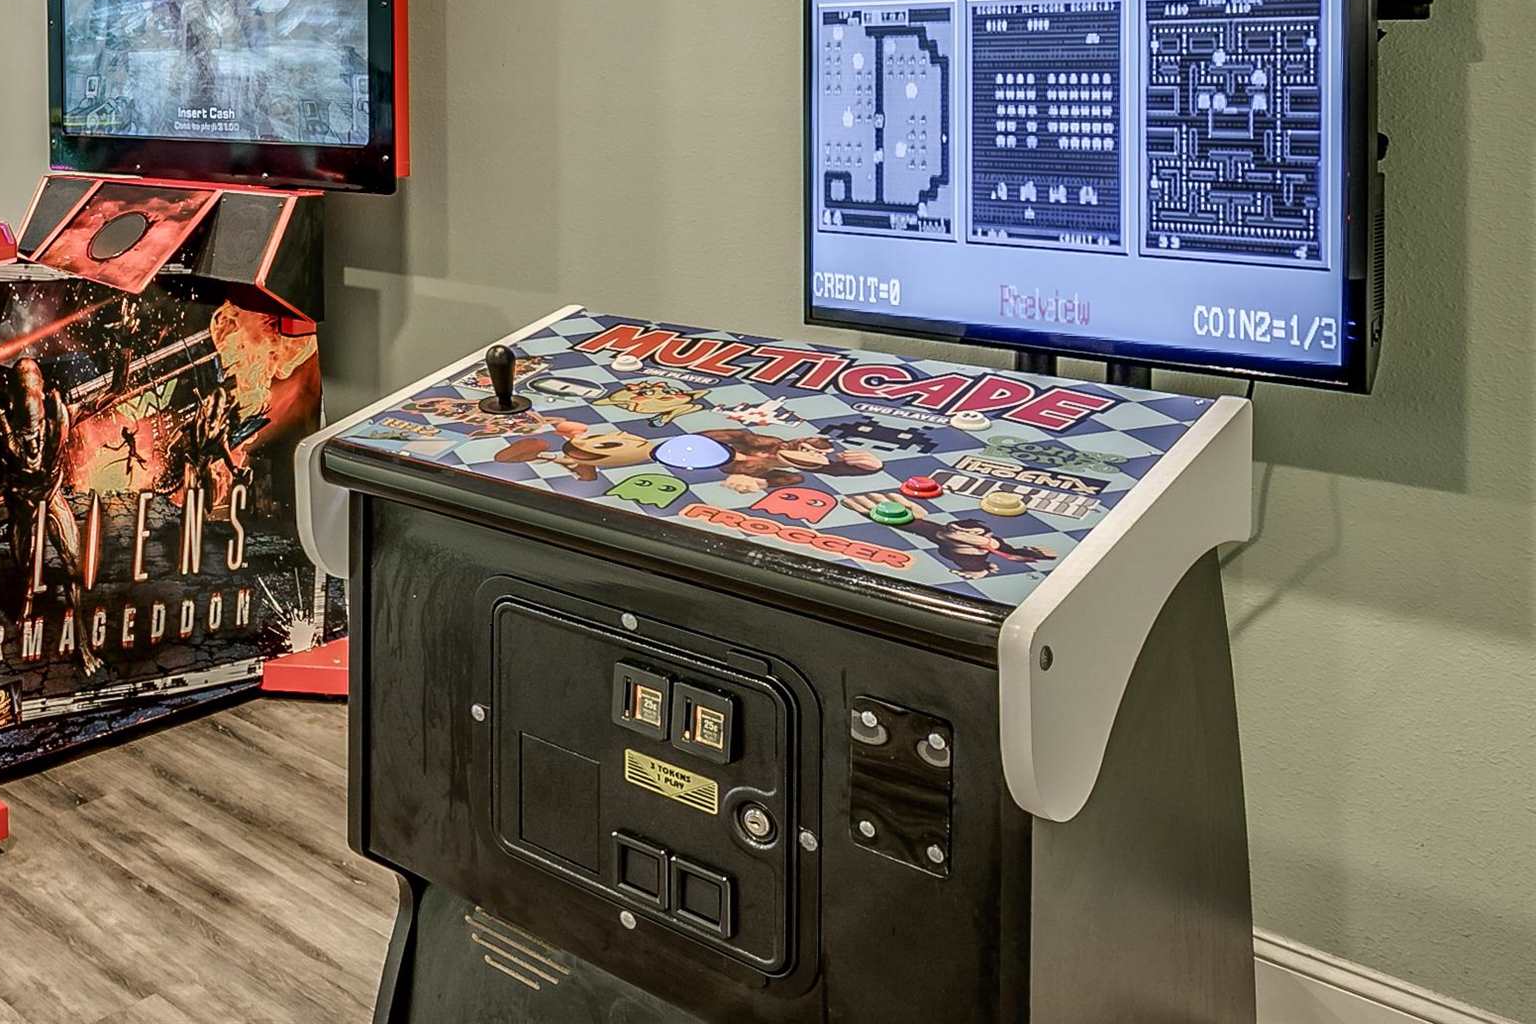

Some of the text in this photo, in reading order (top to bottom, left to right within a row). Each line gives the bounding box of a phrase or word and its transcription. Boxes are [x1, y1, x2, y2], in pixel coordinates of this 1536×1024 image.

[177, 107, 235, 119] Insert Cash
[813, 272, 901, 306] CREDIT=0
[1193, 304, 1338, 351] COIN2=1/3
[574, 324, 1117, 431] MULTICADE
[892, 409, 951, 425] PLAYER
[682, 503, 914, 568] FROGGER
[658, 765, 692, 784] TOKENS
[664, 776, 685, 790] PLAY
